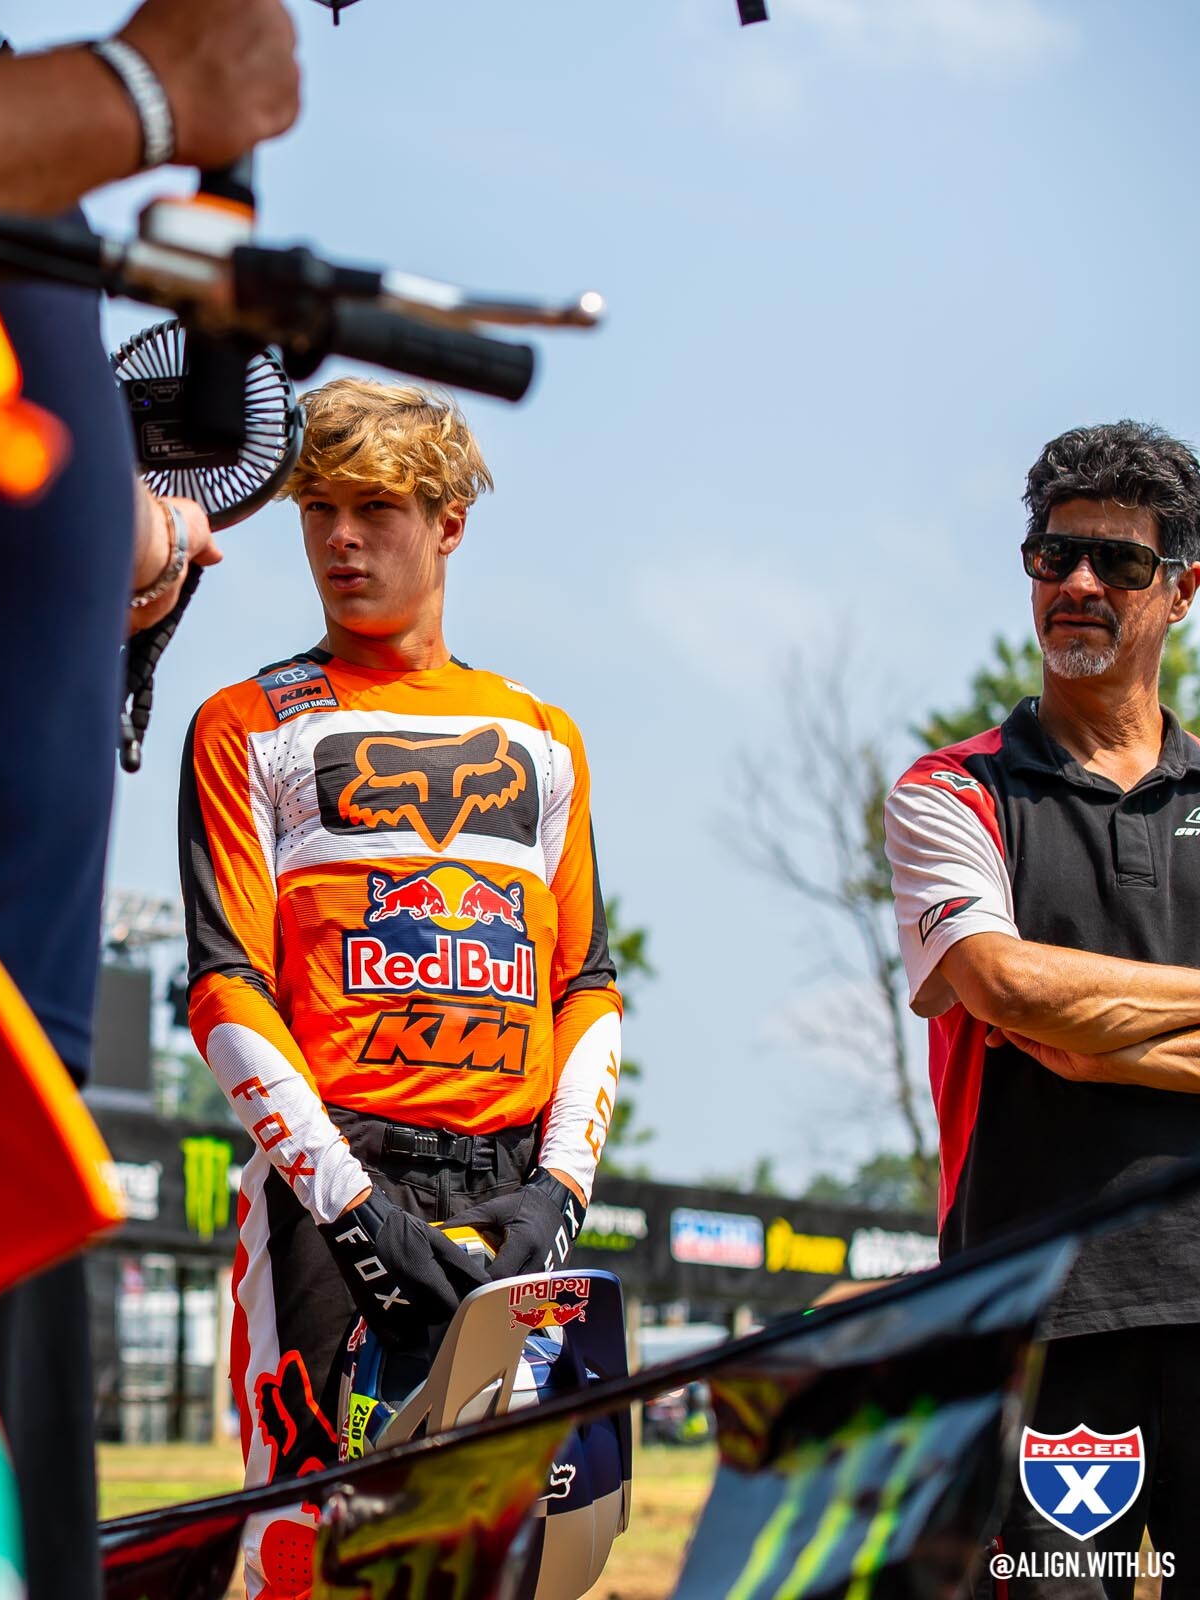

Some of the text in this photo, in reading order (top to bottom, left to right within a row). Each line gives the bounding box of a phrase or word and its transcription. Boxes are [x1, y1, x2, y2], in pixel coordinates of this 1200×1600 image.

[278, 698, 338, 720] AMATEUR RACING
[280, 686, 322, 704] KTM
[350, 934, 535, 999] Red Bull
[357, 1000, 530, 1075] KTM
[231, 1076, 315, 1190] FOX
[335, 1225, 410, 1311] FOX
[509, 1277, 590, 1306] Red Bull
[352, 1403, 370, 1441] 250
